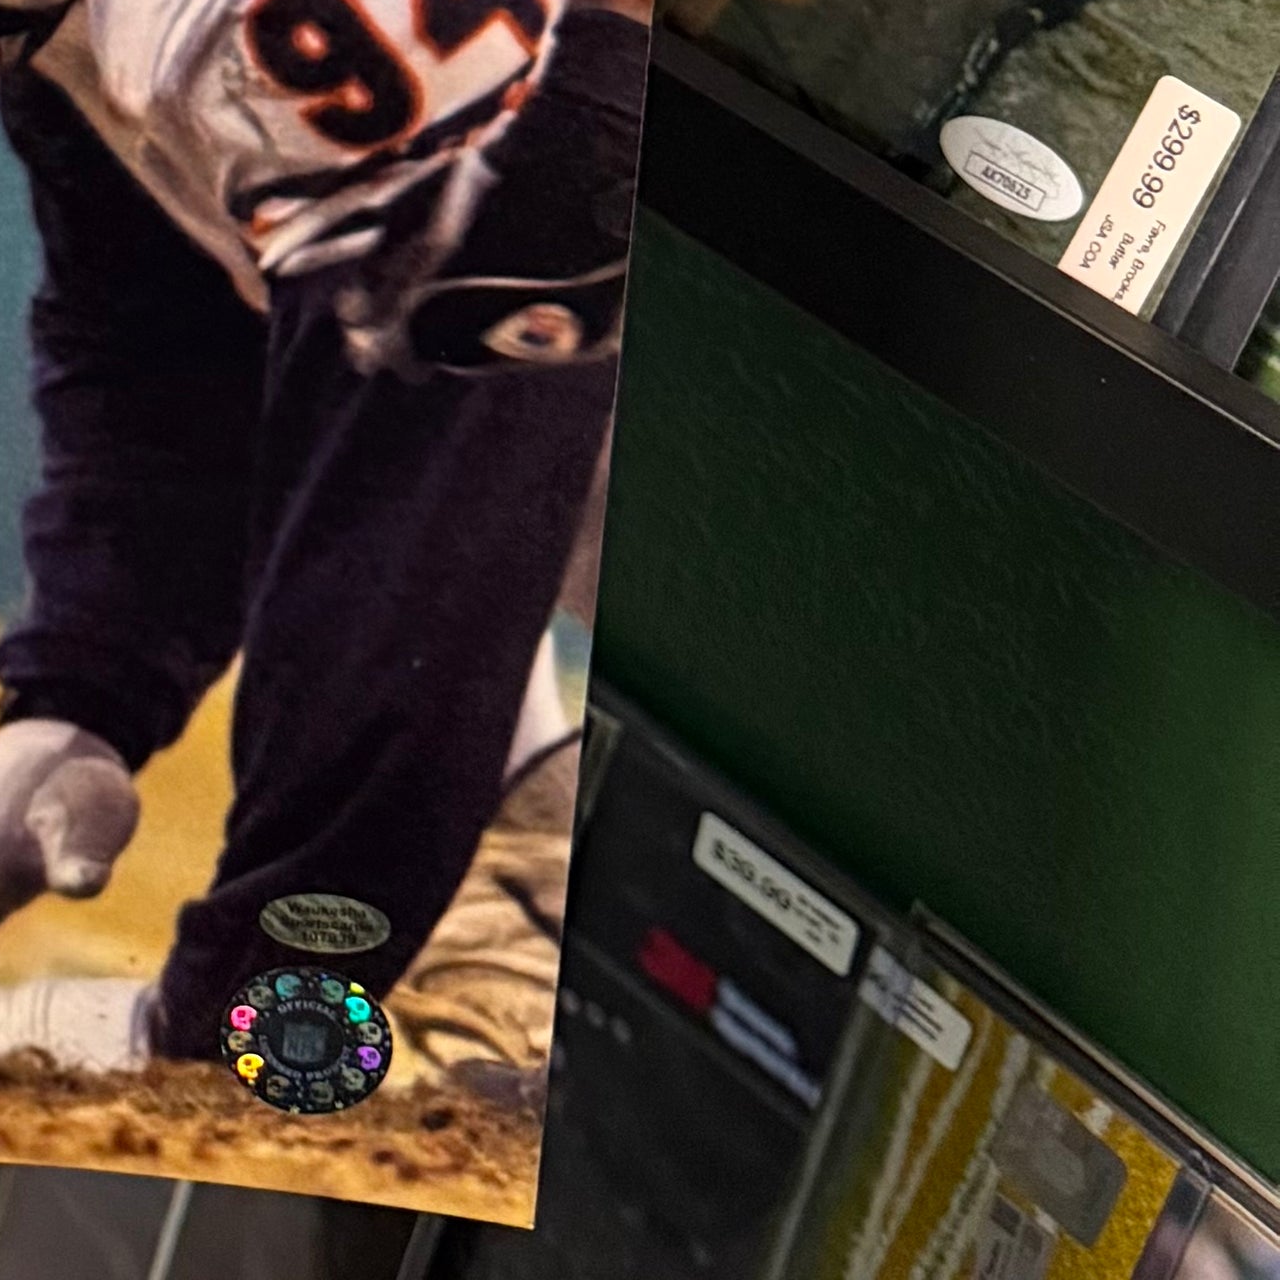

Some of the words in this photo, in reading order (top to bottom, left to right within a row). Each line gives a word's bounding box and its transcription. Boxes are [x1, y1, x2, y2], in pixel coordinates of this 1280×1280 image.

[1132, 103, 1202, 210] $299.99
[1096, 213, 1115, 239] JSA
[1136, 219, 1167, 254] Favre,
[1079, 240, 1103, 270] COA
[1108, 232, 1135, 270] Butler
